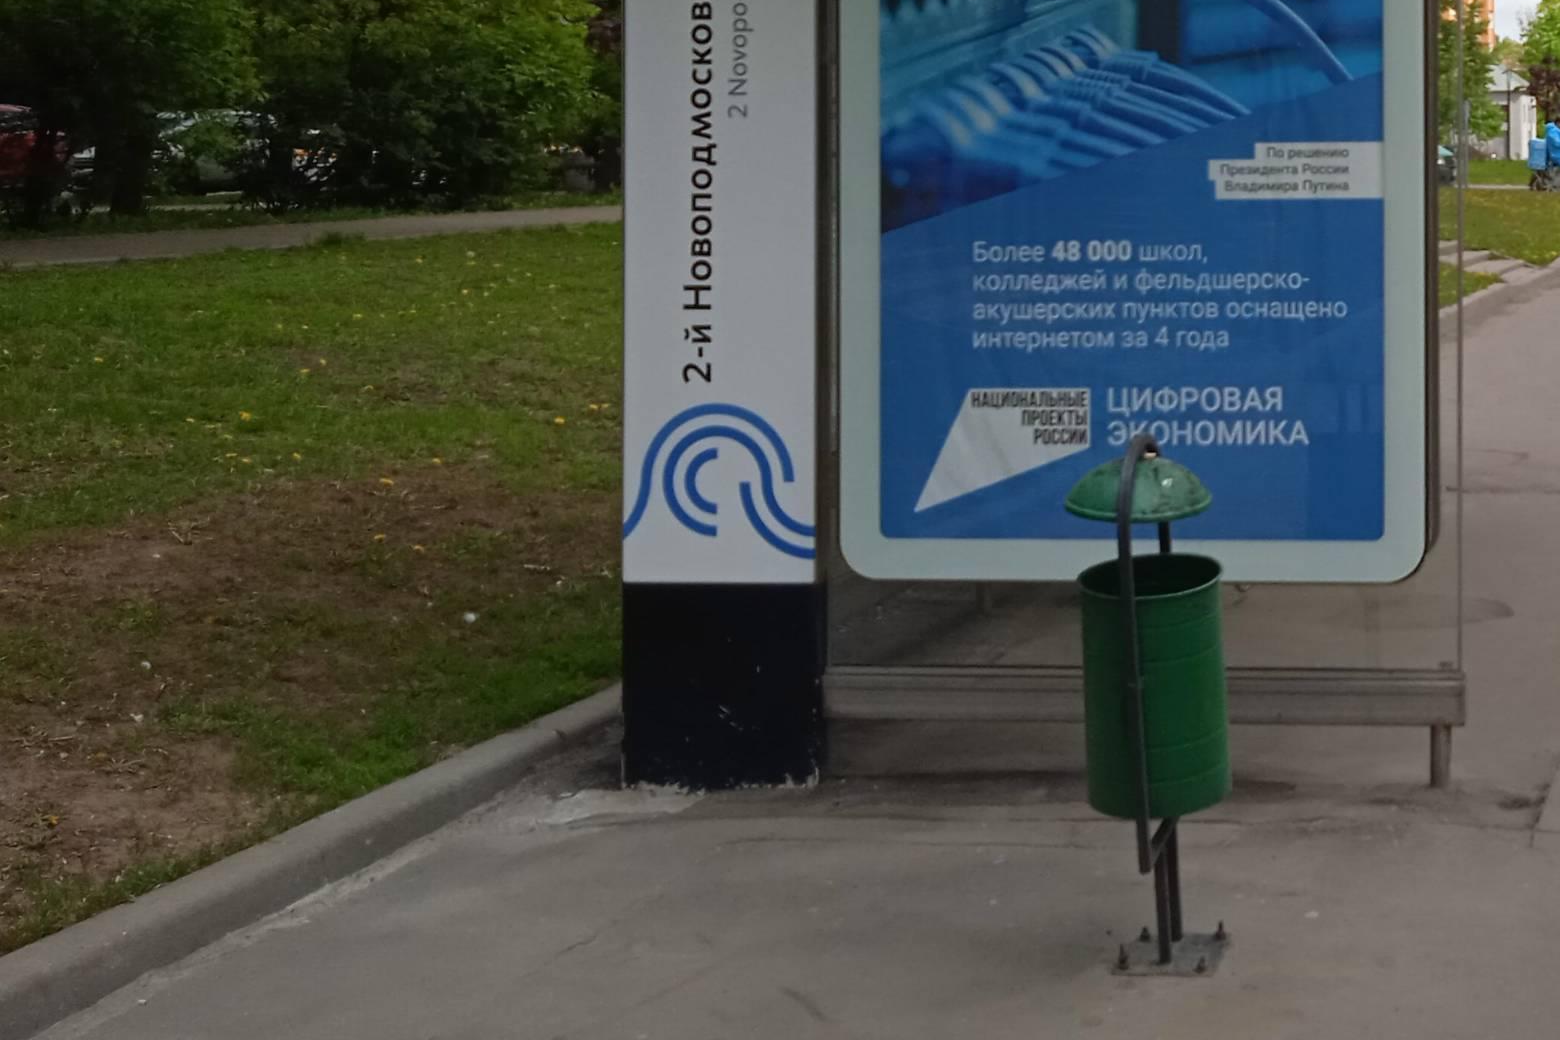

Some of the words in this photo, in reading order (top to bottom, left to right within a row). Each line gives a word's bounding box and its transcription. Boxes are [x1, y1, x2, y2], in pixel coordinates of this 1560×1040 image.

[727, 104, 748, 119] 2
[1266, 147, 1281, 158] По
[1287, 149, 1349, 160] решению
[1220, 164, 1298, 177] Президента
[1302, 164, 1349, 175] России
[1225, 180, 1298, 193] Владимира
[1303, 179, 1349, 194] Путина
[972, 241, 1046, 263] Более
[1052, 240, 1081, 262] 48
[1087, 240, 1132, 261] 000
[1138, 244, 1208, 264] школ,
[972, 269, 1107, 294] колледжей
[1113, 274, 1128, 291] и
[1135, 267, 1311, 295] фельдшерско-
[972, 301, 1116, 325] акушерских
[1122, 301, 1219, 324] пунктов
[1226, 300, 1348, 322] оснащено
[972, 329, 1115, 353] интернетом
[1121, 329, 1149, 348] за
[1154, 325, 1170, 347] 4
[1176, 329, 1230, 351] года
[682, 324, 712, 384] 2-й
[970, 390, 1088, 409] НАЦИОНАЛЬНЫЕ
[1106, 386, 1284, 417] ЦИФРОВАЯ
[1021, 408, 1088, 427] ПРОЕКТЫ
[1033, 428, 1088, 445] РОССИИ
